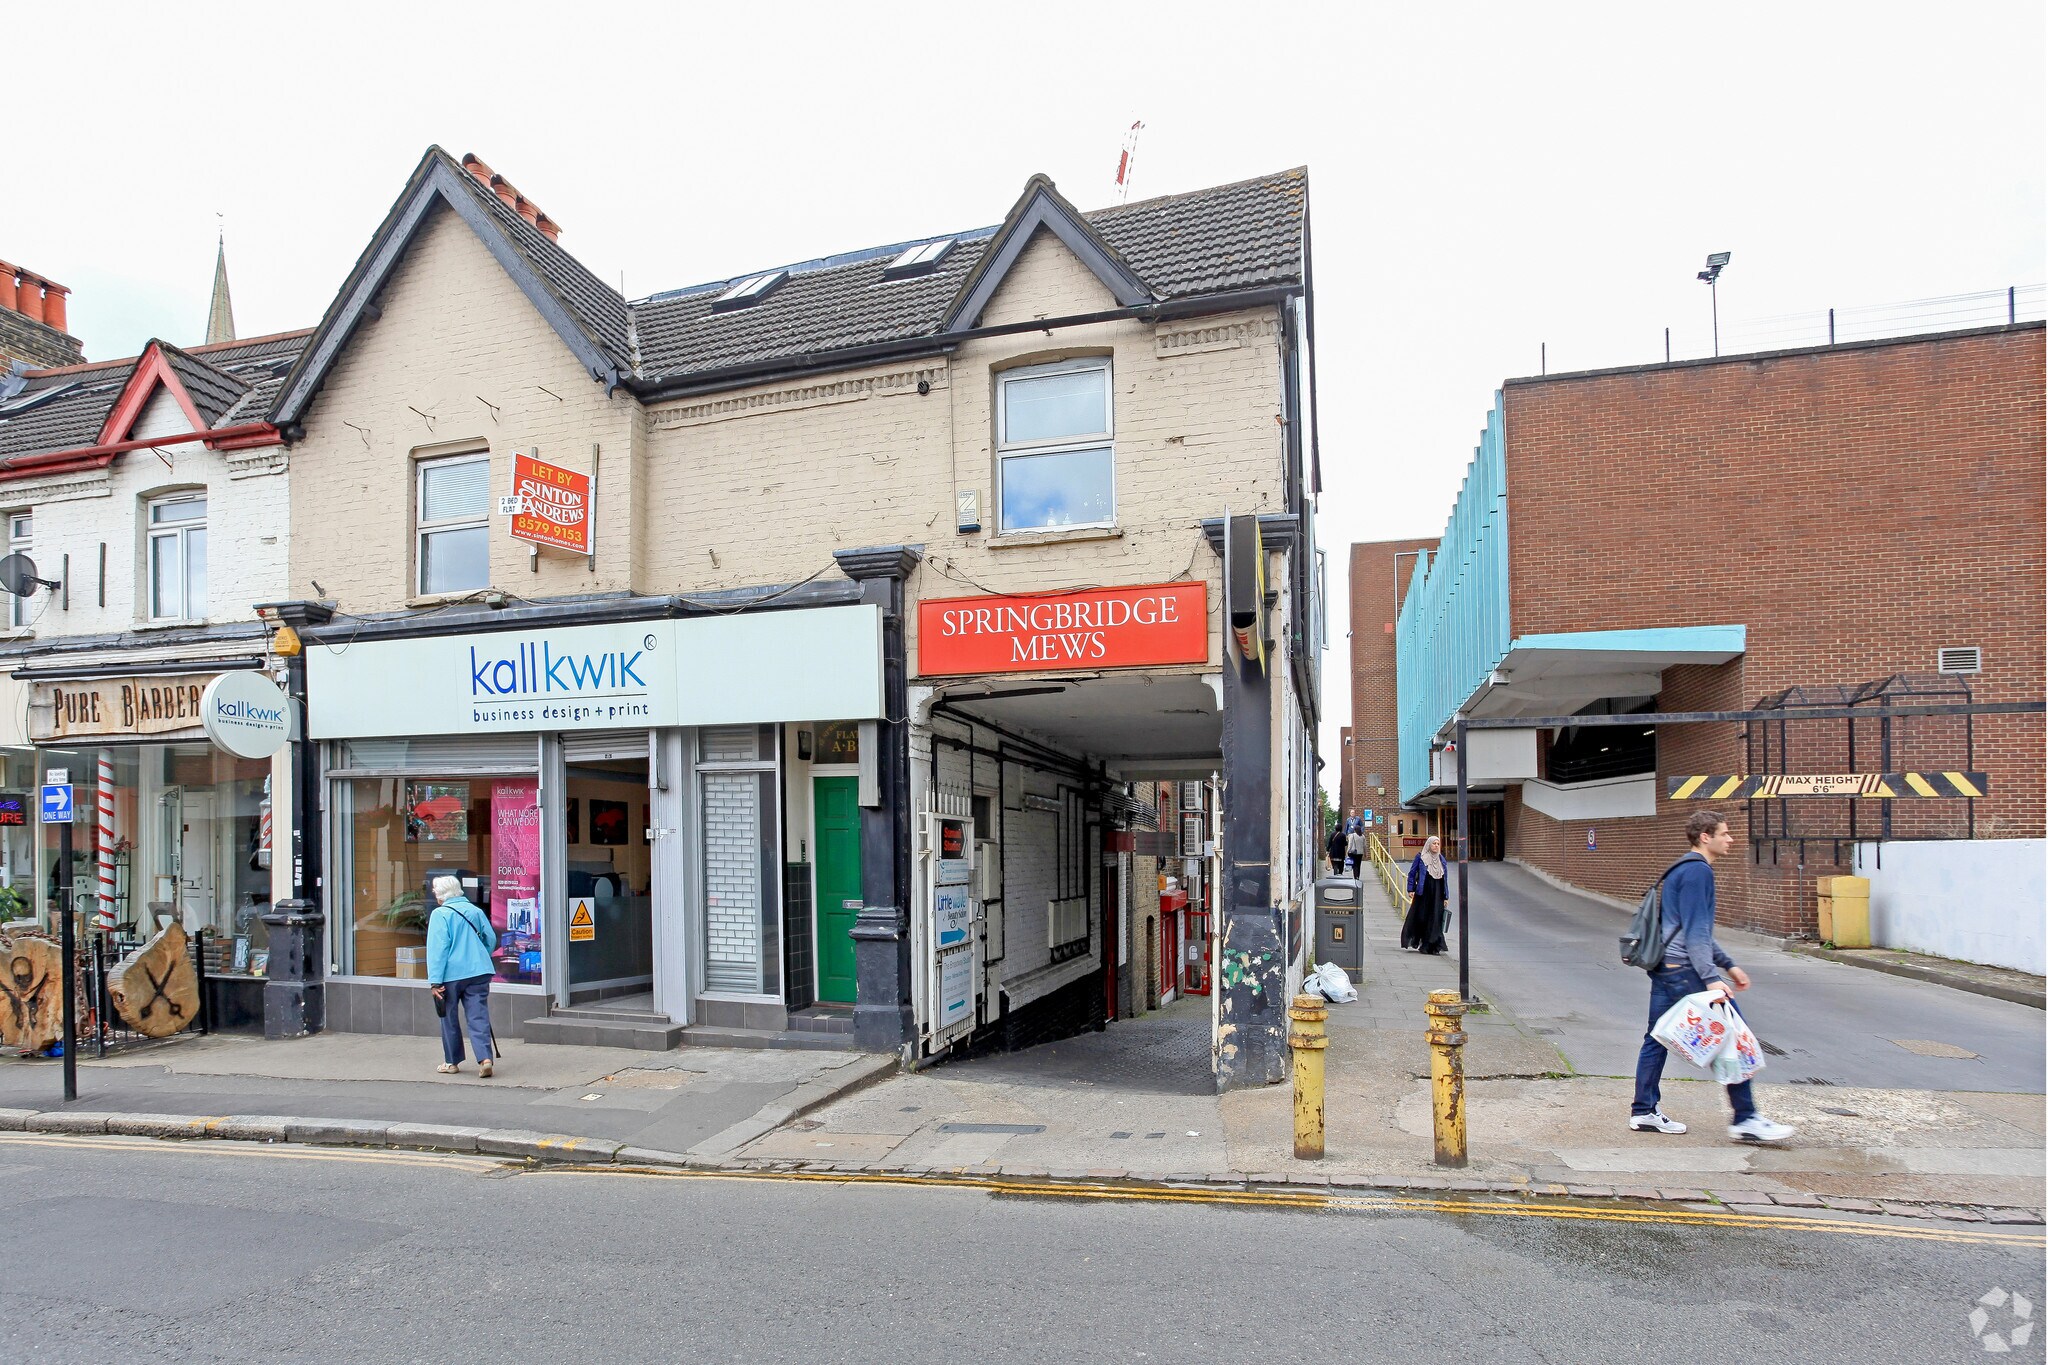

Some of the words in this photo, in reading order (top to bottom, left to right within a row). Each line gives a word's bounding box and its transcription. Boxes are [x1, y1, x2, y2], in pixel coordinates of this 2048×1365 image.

[532, 463, 554, 480] LET
[557, 471, 573, 486] BY
[501, 497, 506, 505] 2
[507, 496, 519, 504] BED
[518, 479, 583, 508] SINTON
[502, 506, 516, 514] FLAT
[522, 498, 584, 524] ANDREWS
[518, 517, 550, 534] 8579
[553, 526, 582, 542] 9153
[514, 528, 585, 550] www.sintonhomes.com
[942, 596, 1179, 636] SPRINGBRIDGE
[1010, 631, 1106, 662] MEWS
[53, 688, 100, 729] PURE
[122, 684, 205, 727] BARBER
[473, 708, 534, 722] business
[542, 705, 590, 721] design
[609, 702, 649, 719] print
[218, 718, 243, 726] business
[246, 721, 264, 729] design
[1815, 776, 1861, 784] HEIGHT
[44, 812, 56, 820] ONE
[58, 811, 71, 820] WAY
[497, 809, 517, 818] WHAT
[518, 809, 539, 818] MORE
[498, 818, 513, 826] CAN
[513, 818, 523, 826] WE
[524, 818, 539, 826] DO?
[498, 867, 512, 875] FOR
[512, 867, 528, 876] YOU.
[937, 894, 953, 911] Little
